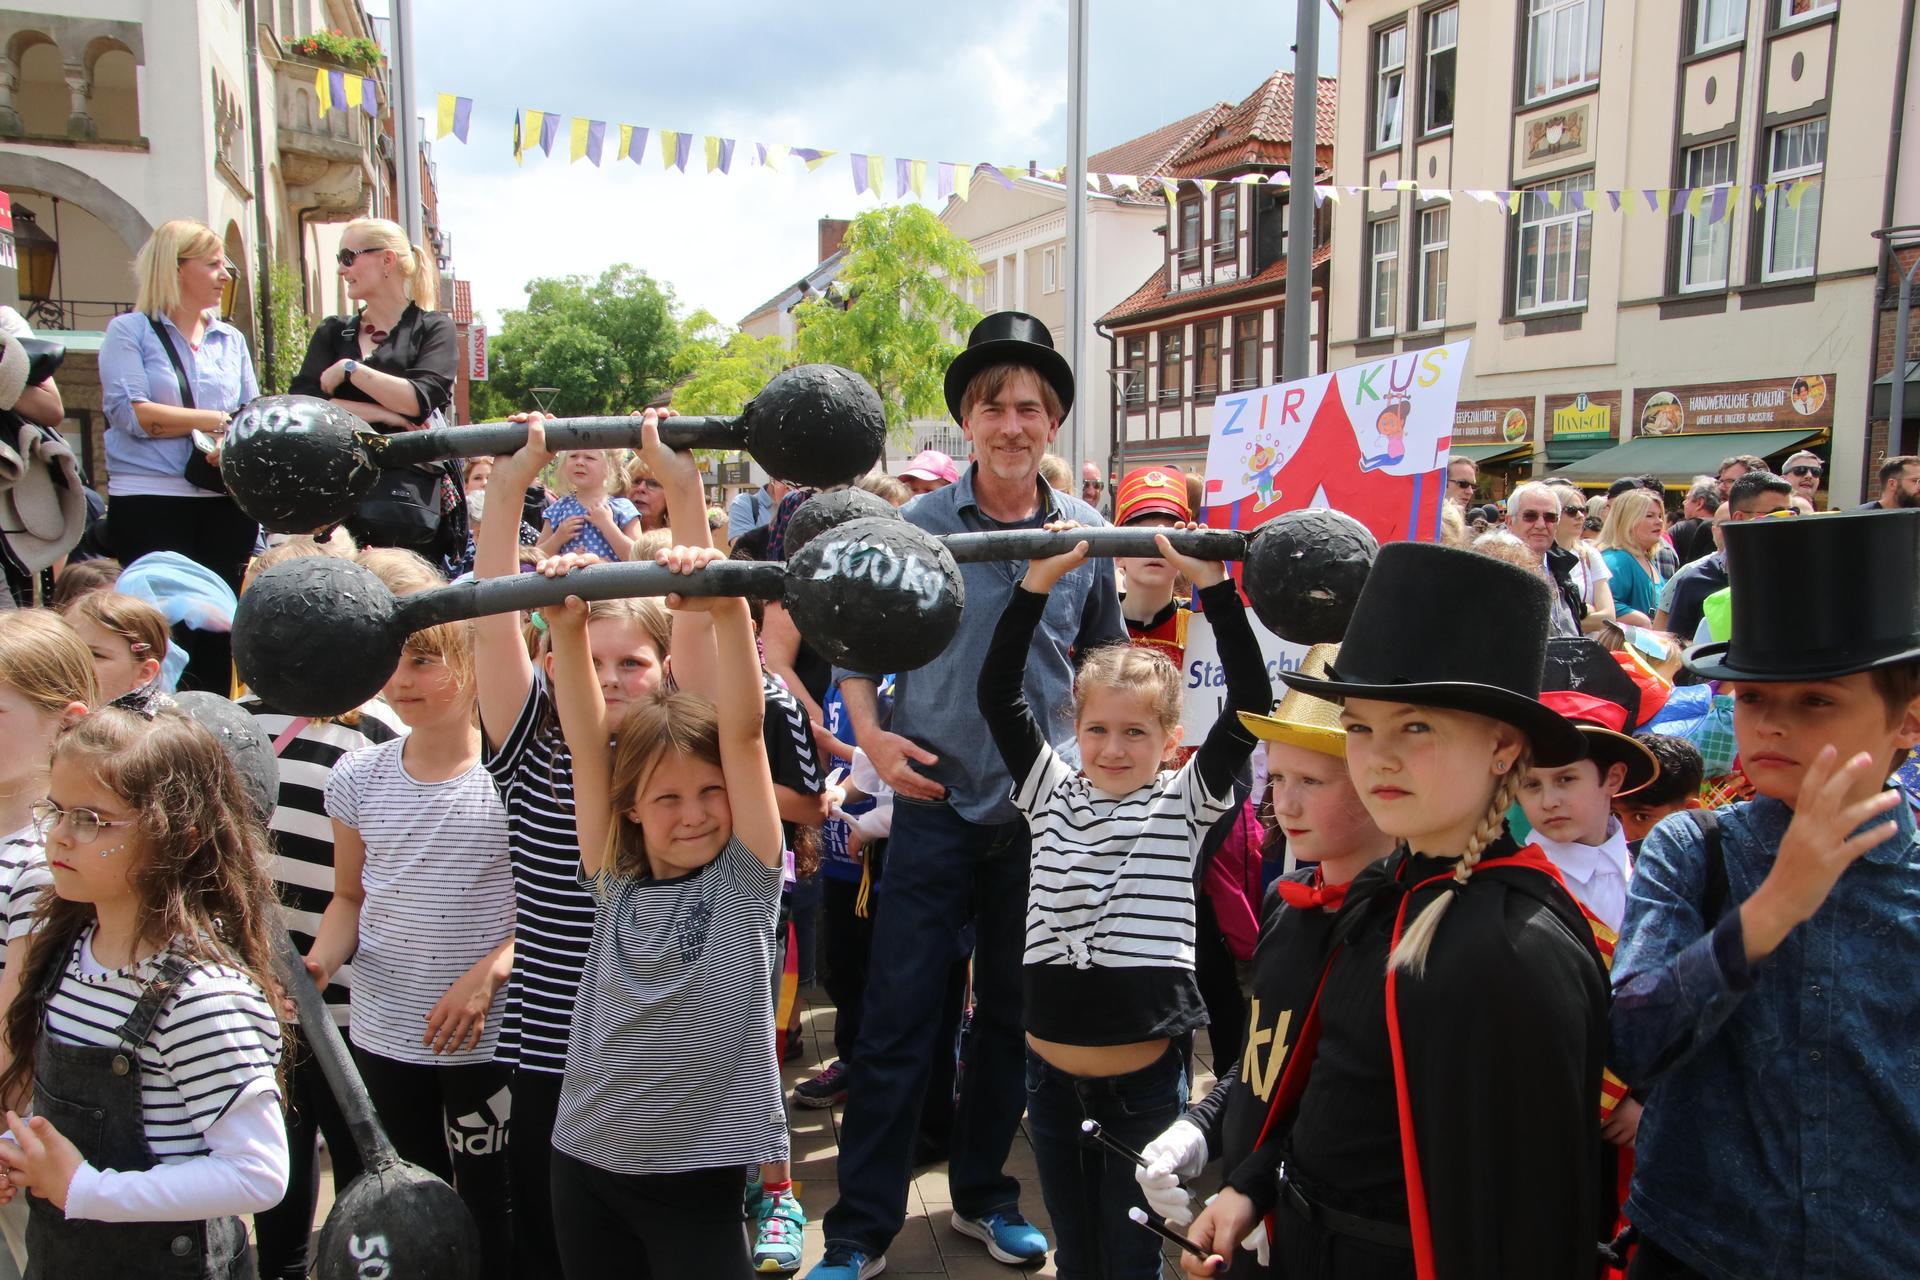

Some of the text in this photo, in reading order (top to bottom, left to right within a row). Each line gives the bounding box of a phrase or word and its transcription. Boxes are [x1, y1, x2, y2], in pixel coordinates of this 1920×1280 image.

[1689, 388, 1784, 411] HANDWERKLICHE QUALITÄT
[1557, 410, 1605, 431] HANISCH
[1879, 451, 1885, 460] 2
